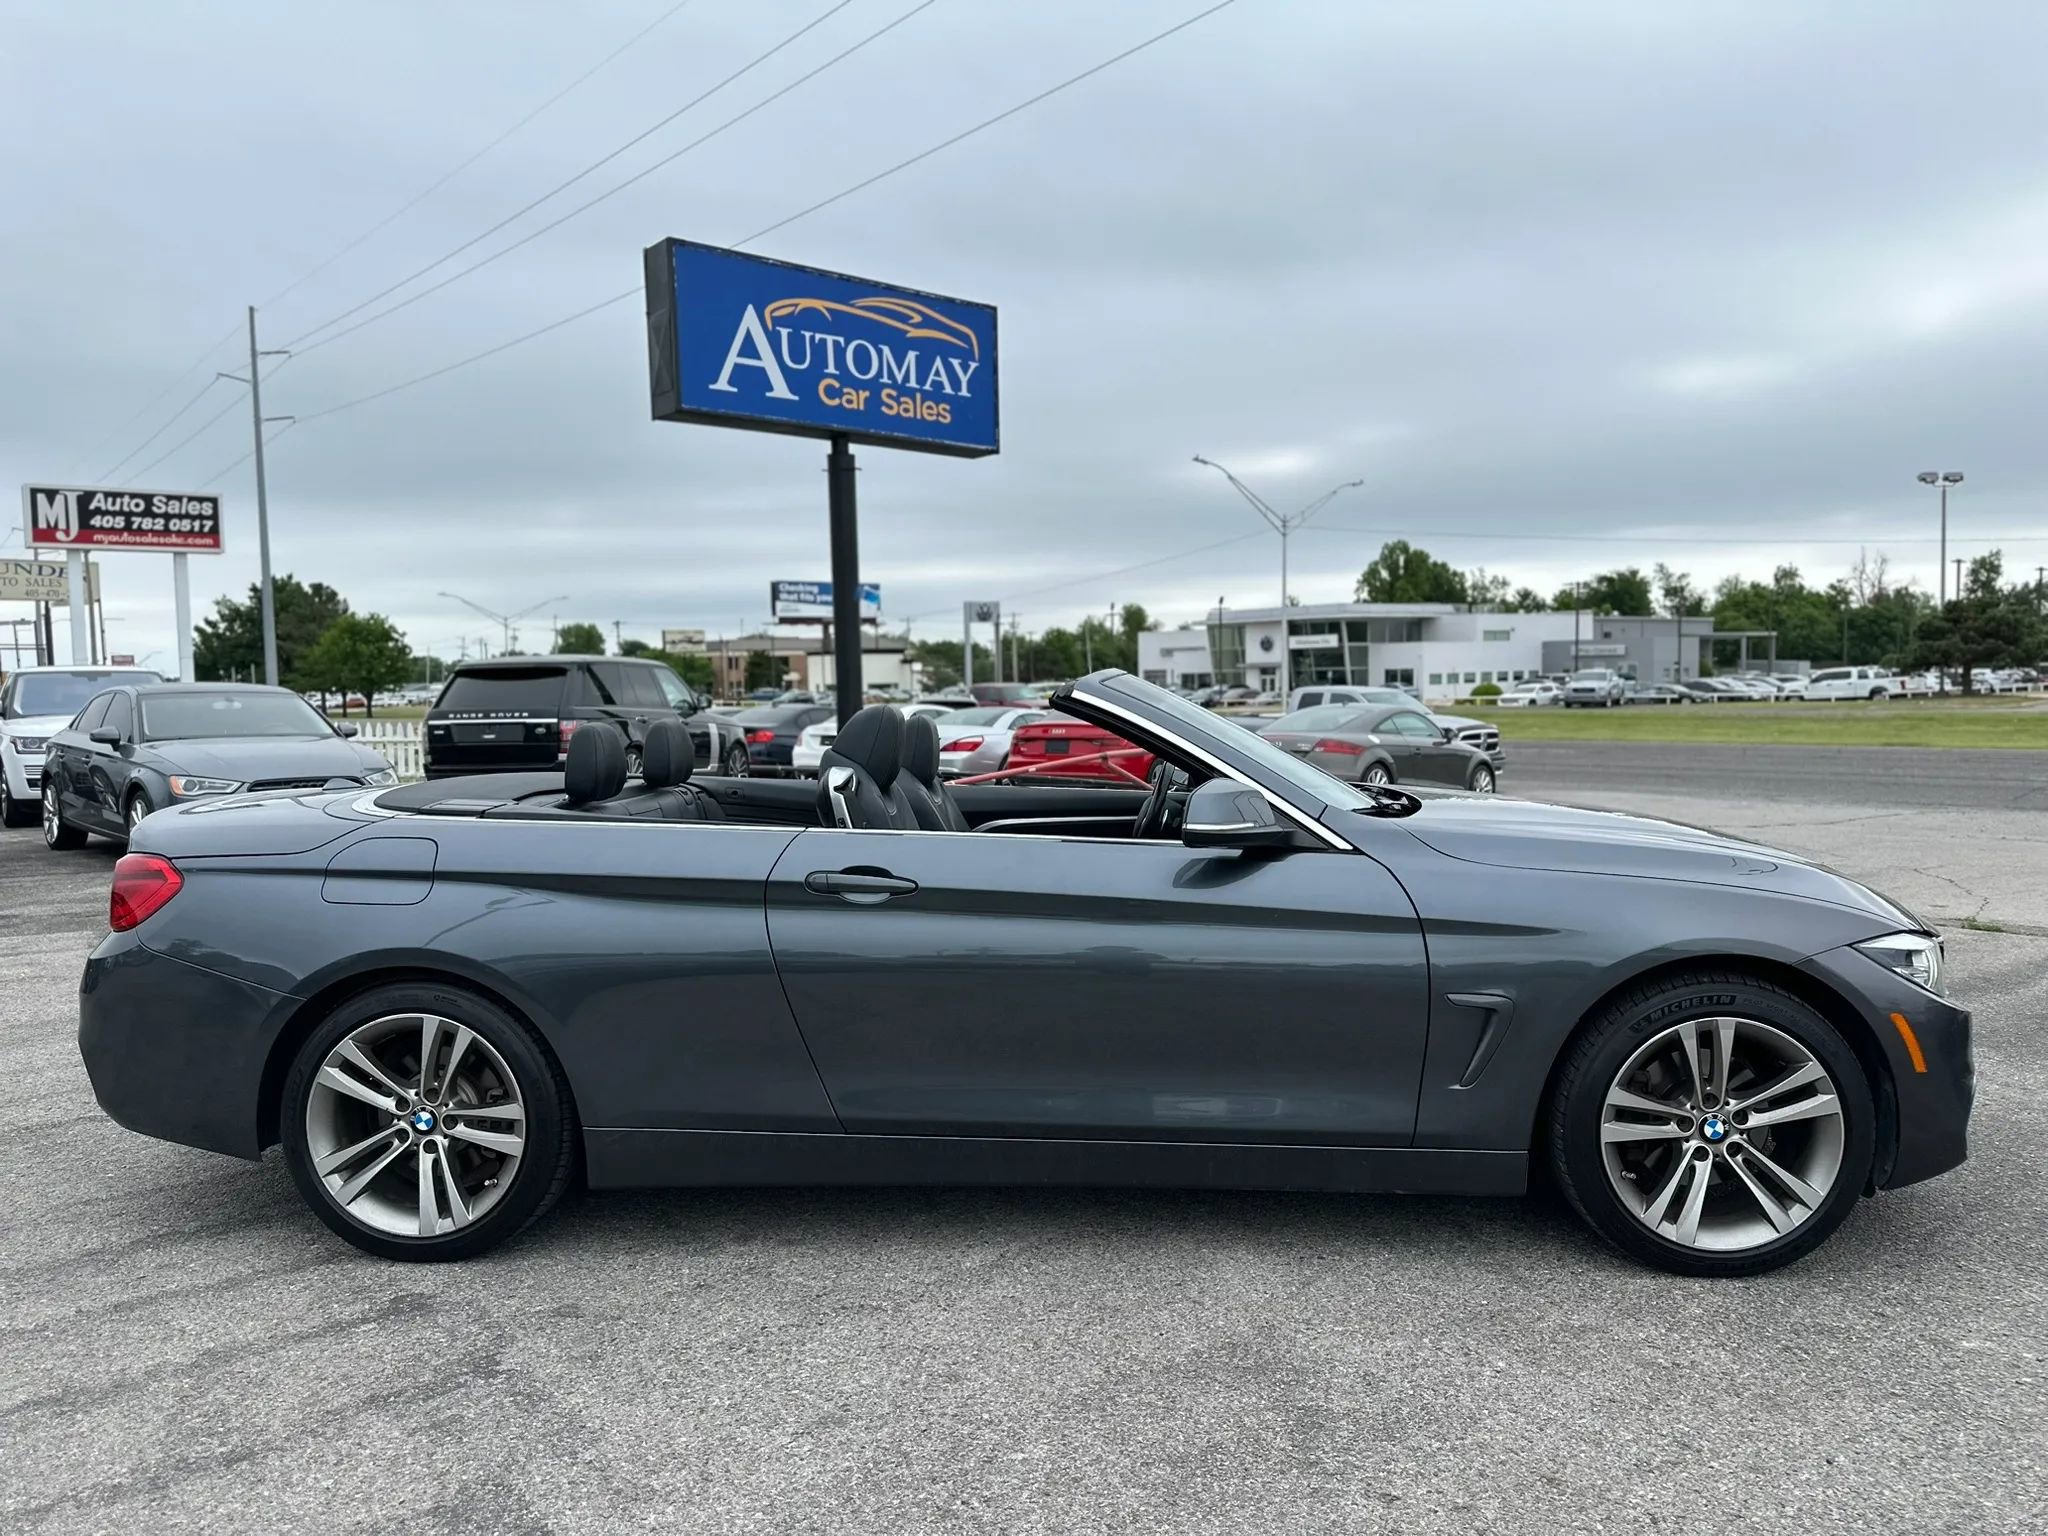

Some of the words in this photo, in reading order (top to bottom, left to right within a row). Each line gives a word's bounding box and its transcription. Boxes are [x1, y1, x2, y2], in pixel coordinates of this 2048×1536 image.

[708, 303, 980, 400] AUTOMAY
[818, 378, 870, 411] Car
[880, 388, 952, 424] Sales
[36, 490, 84, 542] MJ
[89, 493, 145, 512] Auto
[152, 495, 213, 516] Sales
[90, 515, 125, 530] 405
[130, 517, 165, 531] 782
[168, 520, 214, 533] 0517
[25, 577, 63, 588] SALES
[1650, 995, 1732, 1019] MICHELIN
